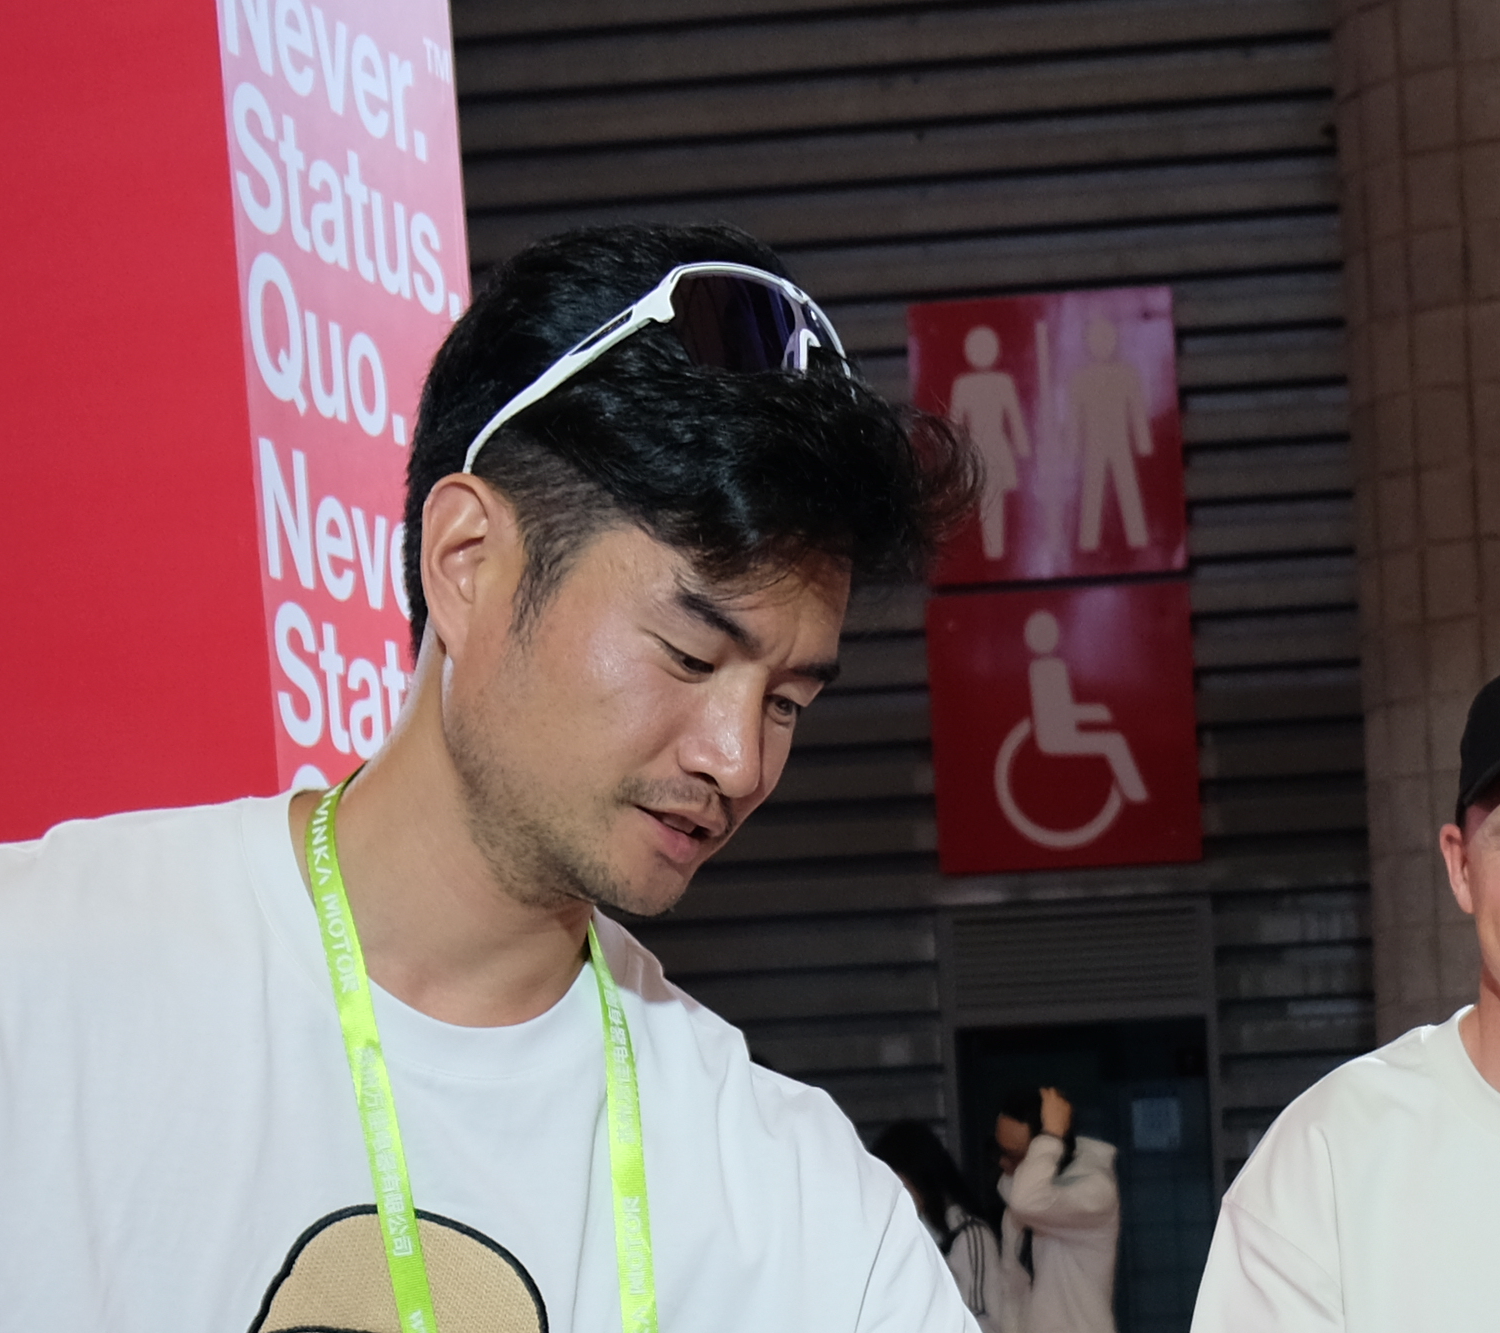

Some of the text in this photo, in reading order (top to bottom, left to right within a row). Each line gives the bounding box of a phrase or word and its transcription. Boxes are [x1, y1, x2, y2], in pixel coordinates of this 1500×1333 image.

[232, 82, 463, 319] Status.
[247, 251, 407, 445] Quo.
[258, 437, 411, 620] Nev
[274, 601, 408, 760] Stat
